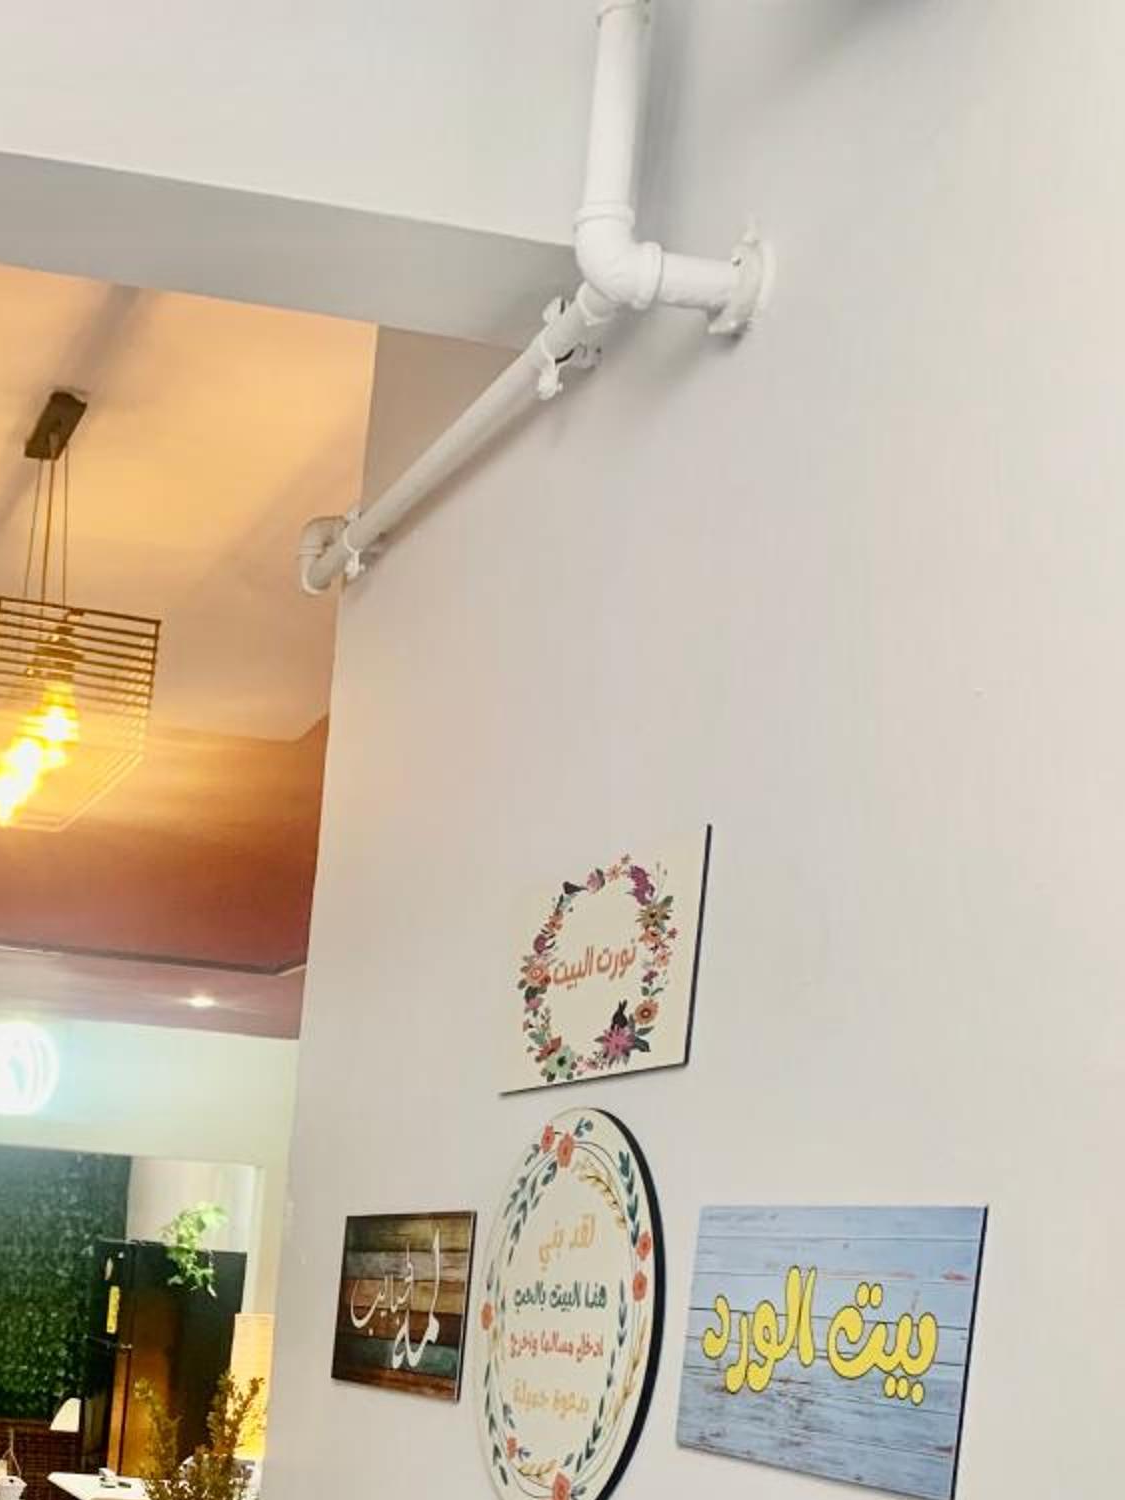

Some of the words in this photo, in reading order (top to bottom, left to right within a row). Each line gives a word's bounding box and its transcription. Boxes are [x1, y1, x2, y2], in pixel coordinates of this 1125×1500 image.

[553, 946, 594, 990] البيت
[596, 939, 636, 980] نورت
[514, 1280, 546, 1313] بالحب
[549, 1280, 582, 1311] البيت
[701, 1264, 818, 1394] الورد
[827, 1281, 939, 1407] بيت
